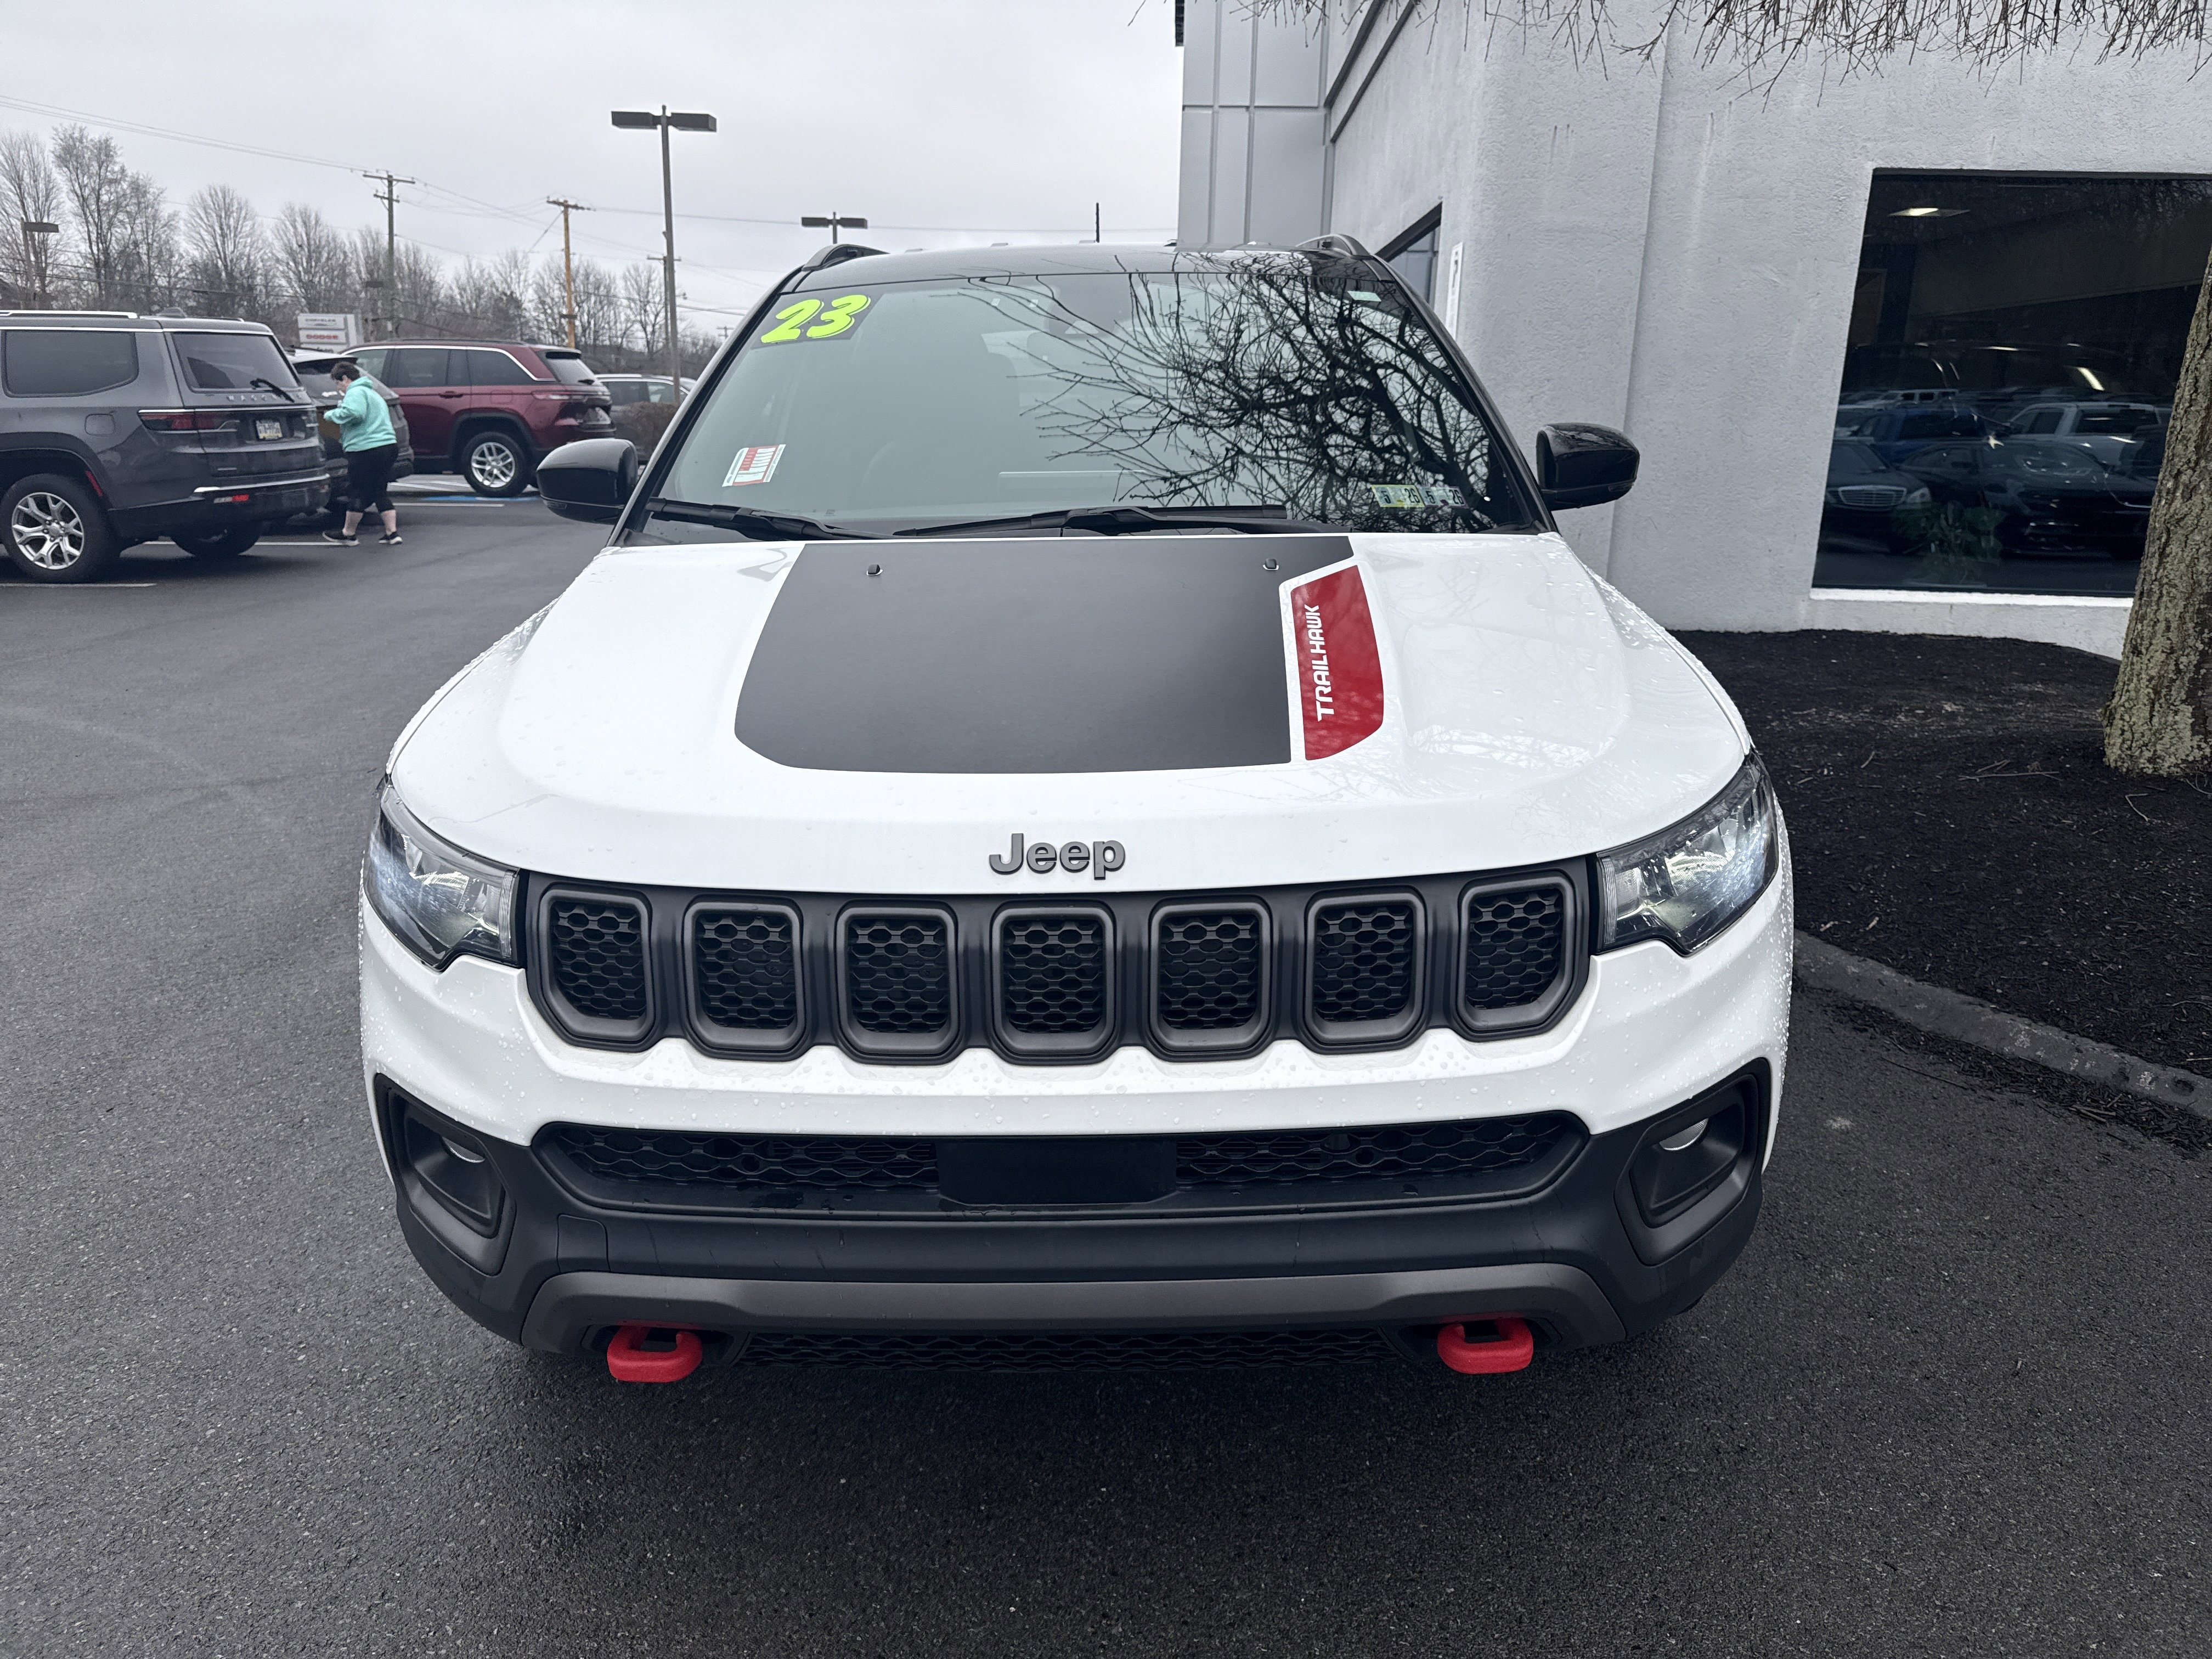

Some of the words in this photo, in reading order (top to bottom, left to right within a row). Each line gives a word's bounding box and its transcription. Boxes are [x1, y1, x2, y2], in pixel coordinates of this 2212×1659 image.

[761, 295, 871, 343] 23
[1381, 490, 1391, 504] 5
[1404, 488, 1420, 504] 26
[1425, 490, 1436, 504] 5
[1449, 489, 1464, 505] 26
[1304, 604, 1335, 723] TRAILHAWK
[989, 833, 1125, 880] Jeep
